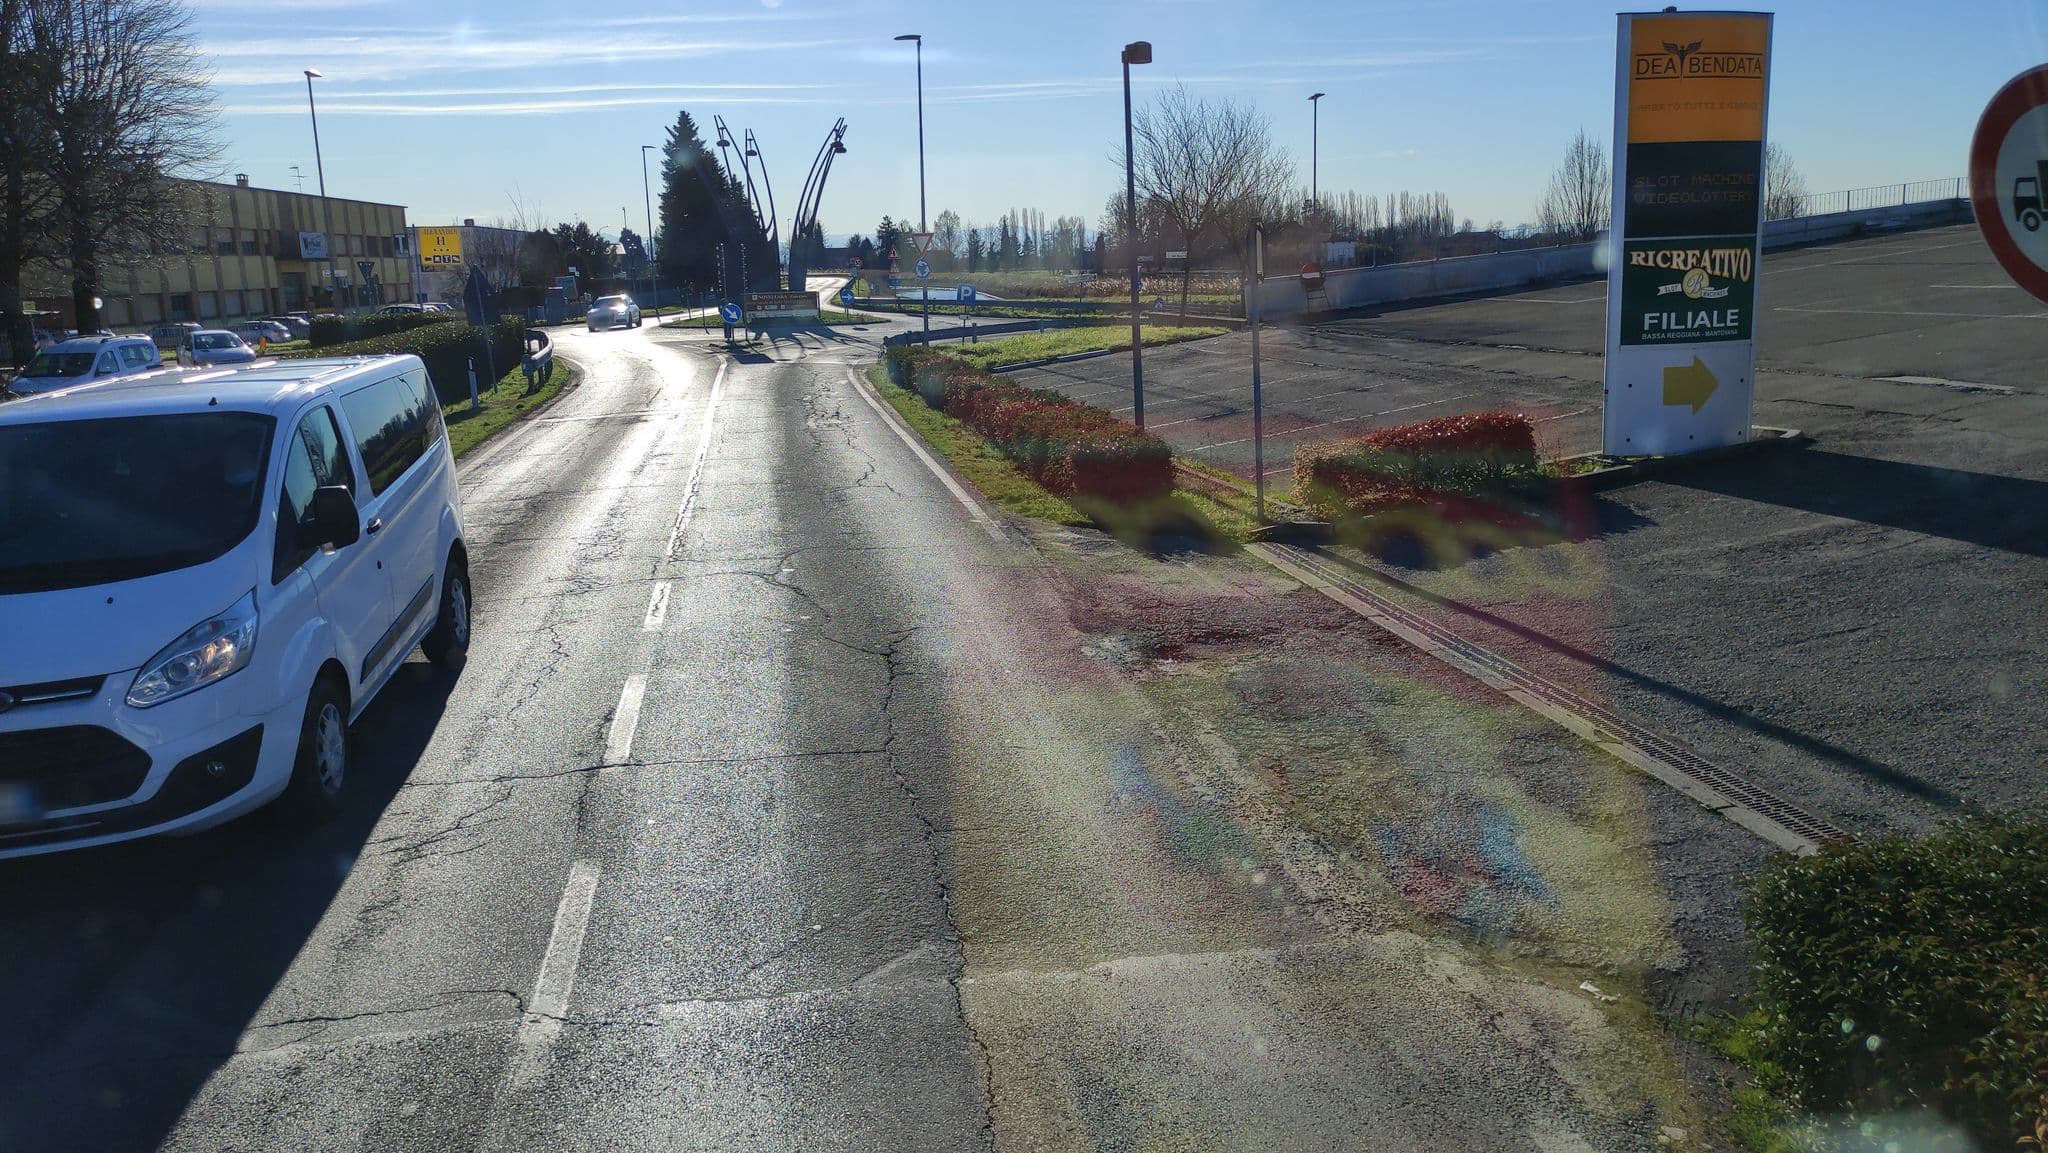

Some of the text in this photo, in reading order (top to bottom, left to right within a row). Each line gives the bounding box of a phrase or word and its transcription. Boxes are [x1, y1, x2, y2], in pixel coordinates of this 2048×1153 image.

[1636, 57, 1762, 75] DEA BENDATA
[1630, 248, 1751, 282] RICREATIVO
[961, 286, 973, 301] P
[1643, 309, 1739, 331] FILIALE
[1641, 332, 1666, 340] BASSA
[1667, 331, 1700, 339] REGGIANA
